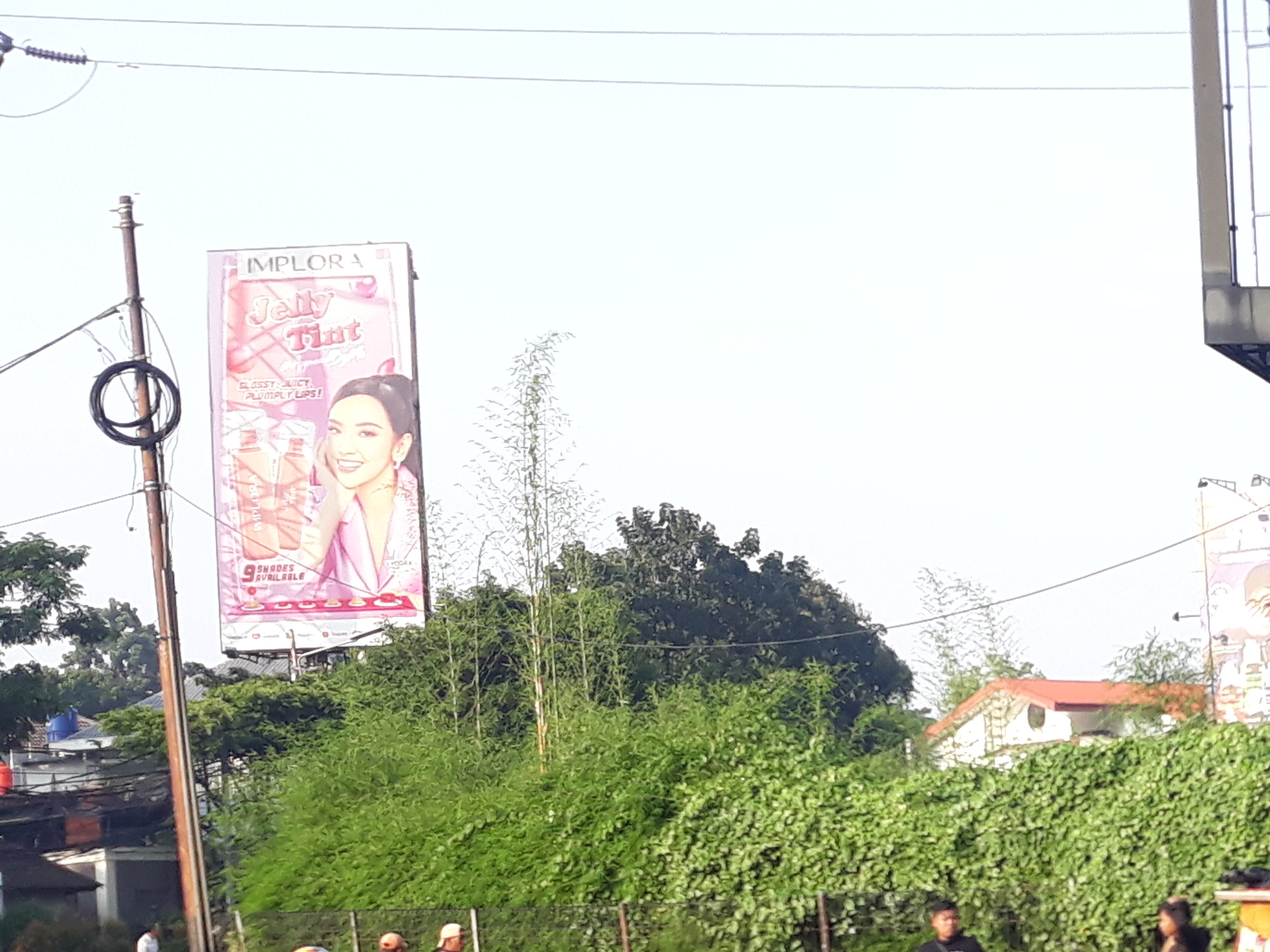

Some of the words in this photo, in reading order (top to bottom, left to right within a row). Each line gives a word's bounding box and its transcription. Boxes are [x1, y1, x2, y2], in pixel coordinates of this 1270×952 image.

[246, 254, 364, 274] IMPLORA
[248, 290, 335, 325] Jelly
[287, 321, 362, 351] Tint
[294, 387, 323, 400] LIPS!
[242, 564, 256, 583] 9
[257, 564, 295, 574] SHADES
[256, 573, 305, 583] AVAILABLE
